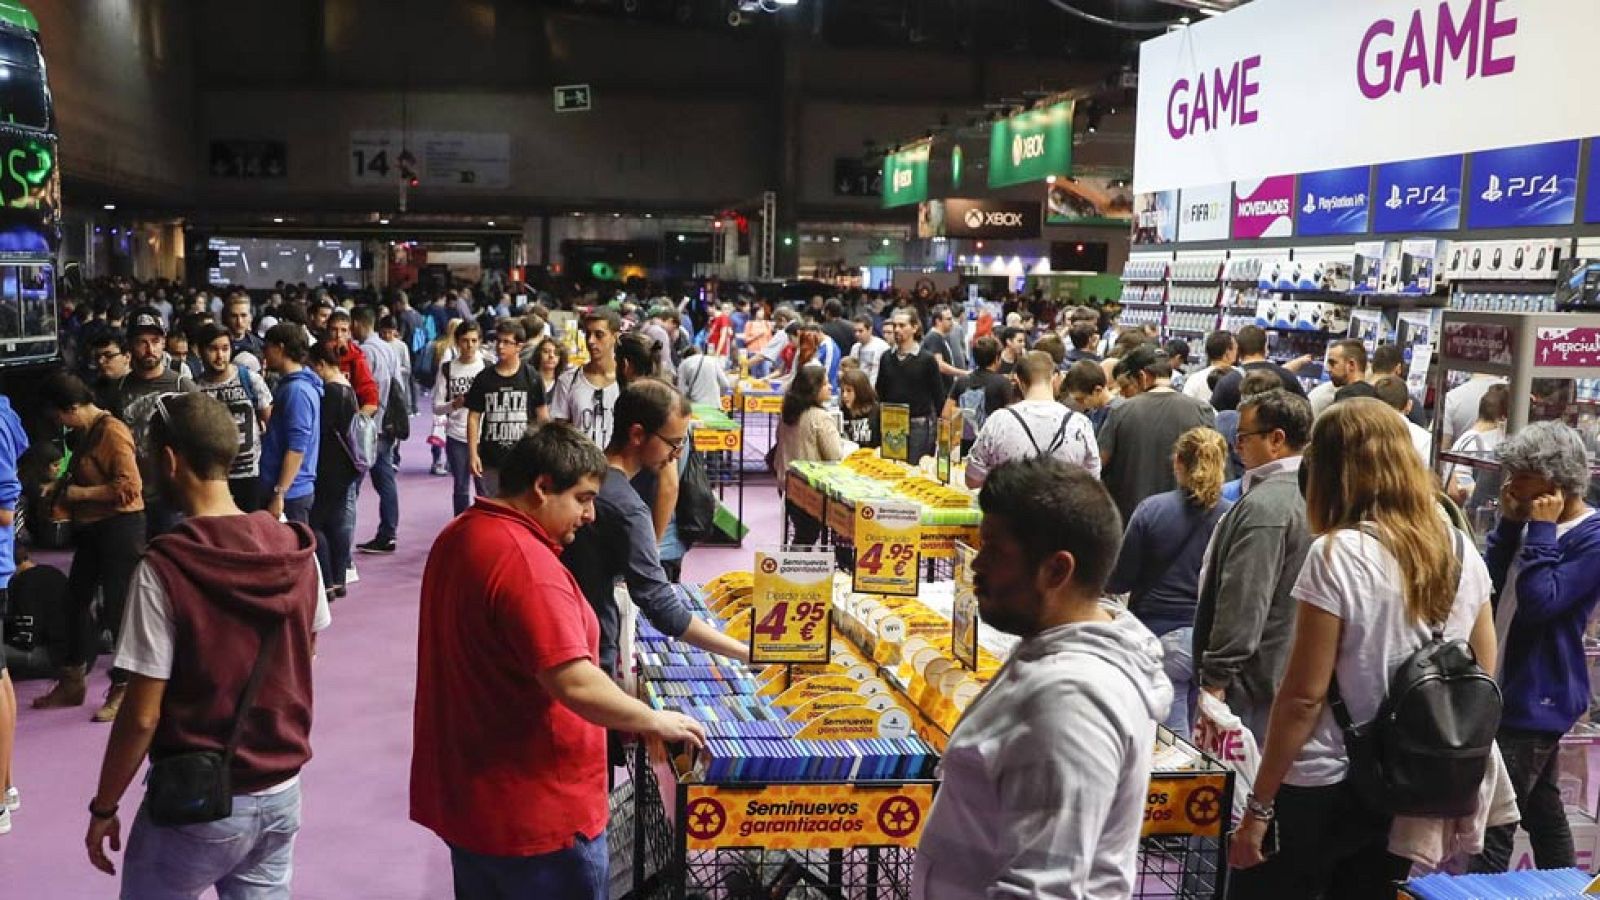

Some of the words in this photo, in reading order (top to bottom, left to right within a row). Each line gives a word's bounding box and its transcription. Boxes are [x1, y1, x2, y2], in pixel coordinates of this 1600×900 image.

[1357, 0, 1517, 100] GAME
[1167, 55, 1261, 140] GAME
[1022, 133, 1045, 160] XBOX
[353, 150, 390, 177] 14
[1406, 184, 1447, 205] PS4
[1508, 175, 1560, 197] PS4
[1191, 203, 1209, 222] FIFA
[1238, 198, 1289, 217] NOVEDADES
[1318, 195, 1354, 212] PlayStation
[985, 212, 1022, 227] XBOX
[1552, 342, 1600, 352] MERCHA
[485, 391, 528, 413] PLATA
[783, 558, 827, 566] Seminuevos
[767, 591, 798, 601] Desde
[745, 801, 858, 816] Seminuevos
[739, 816, 864, 836] garantizados
